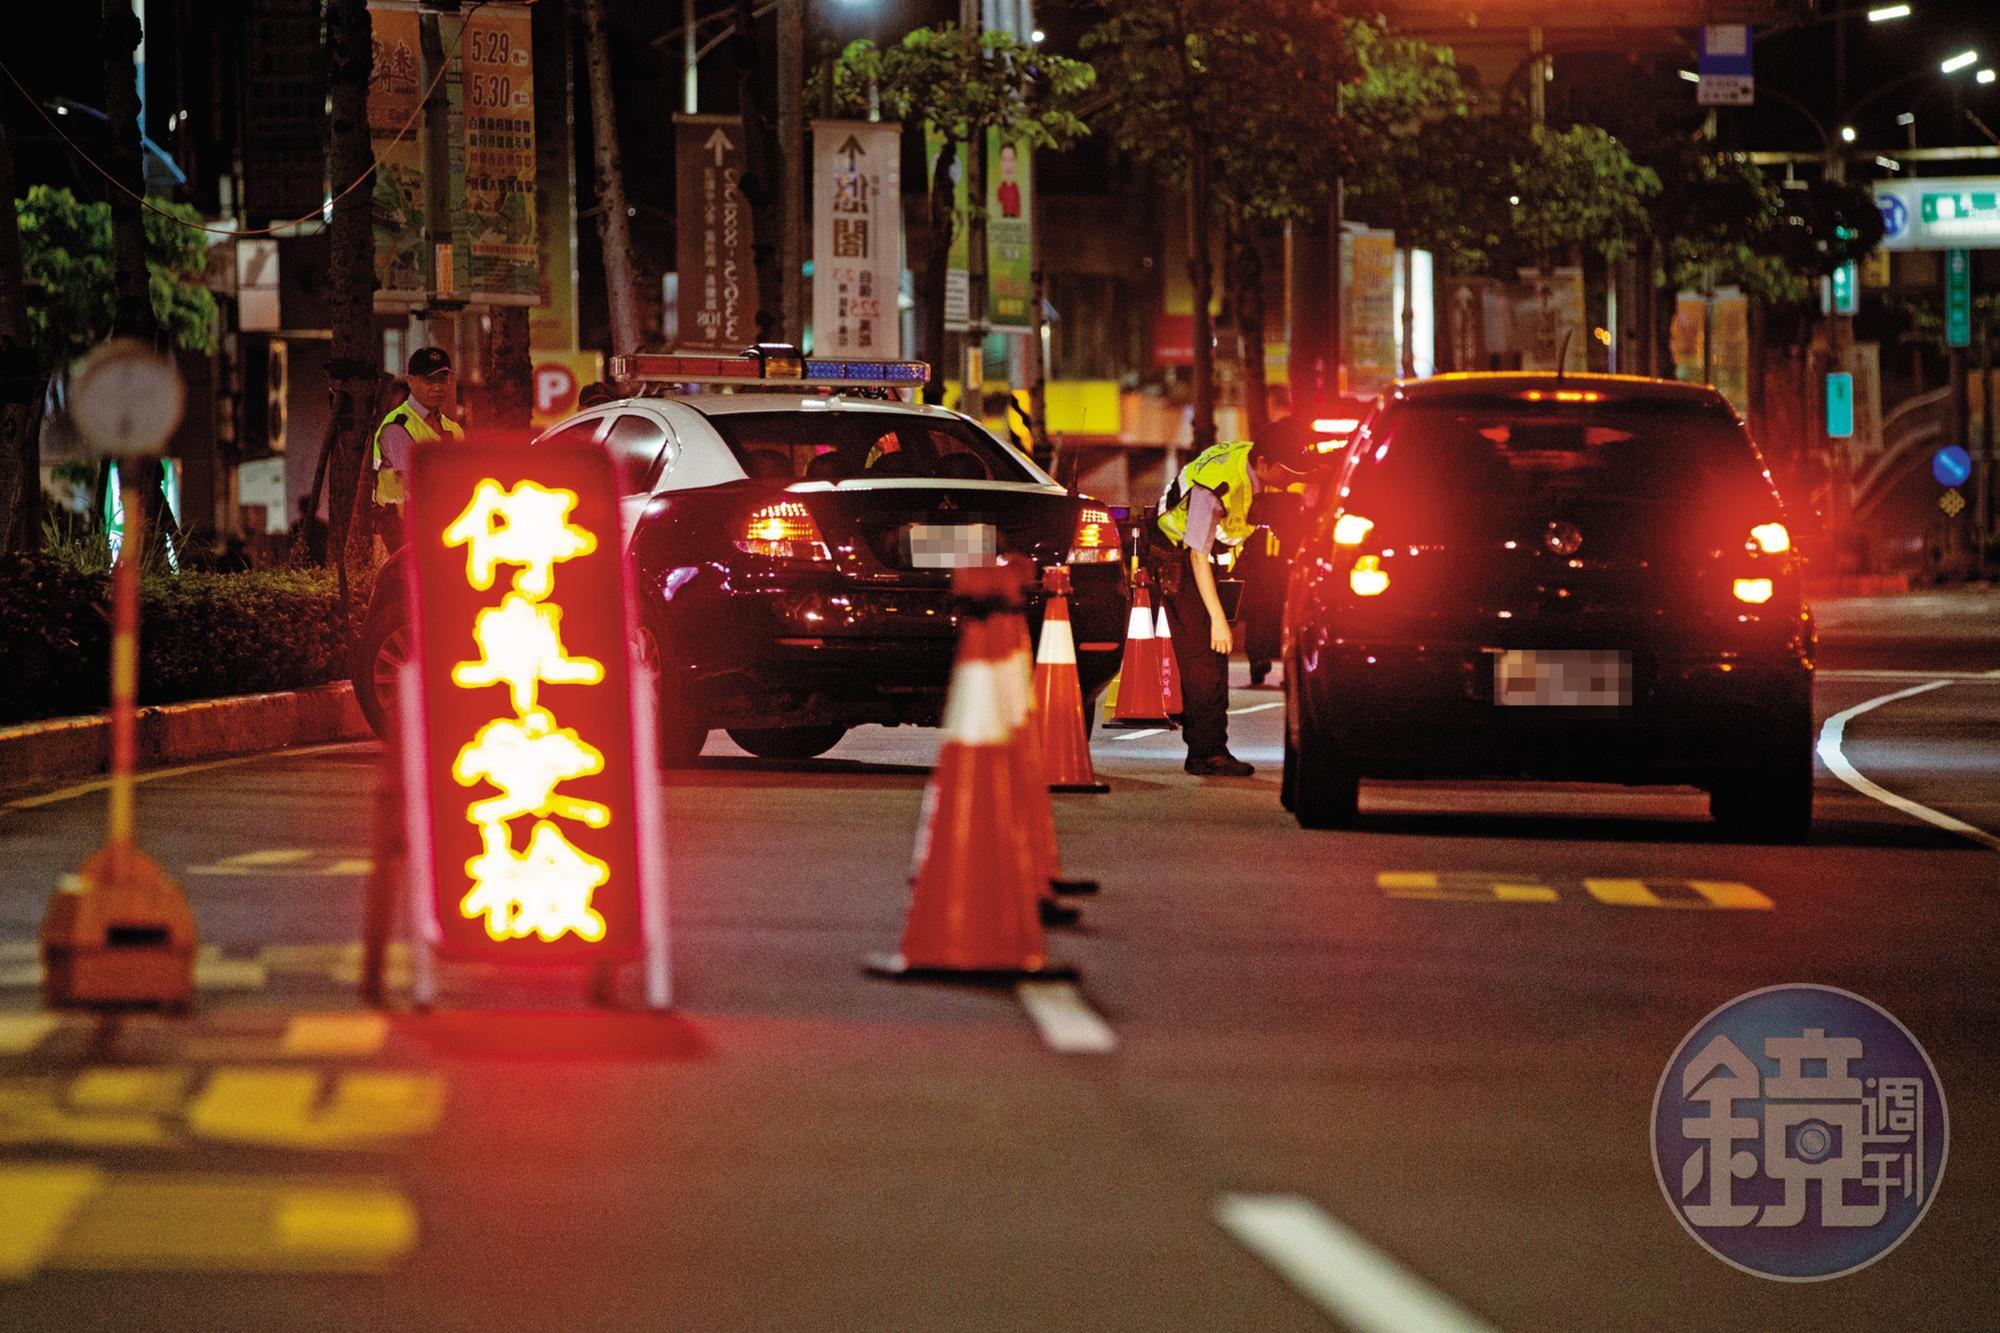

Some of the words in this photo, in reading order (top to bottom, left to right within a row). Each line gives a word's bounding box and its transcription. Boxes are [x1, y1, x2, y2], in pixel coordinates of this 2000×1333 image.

[472, 31, 510, 64] 5.29
[473, 74, 511, 107] 5.30
[538, 371, 570, 410] P
